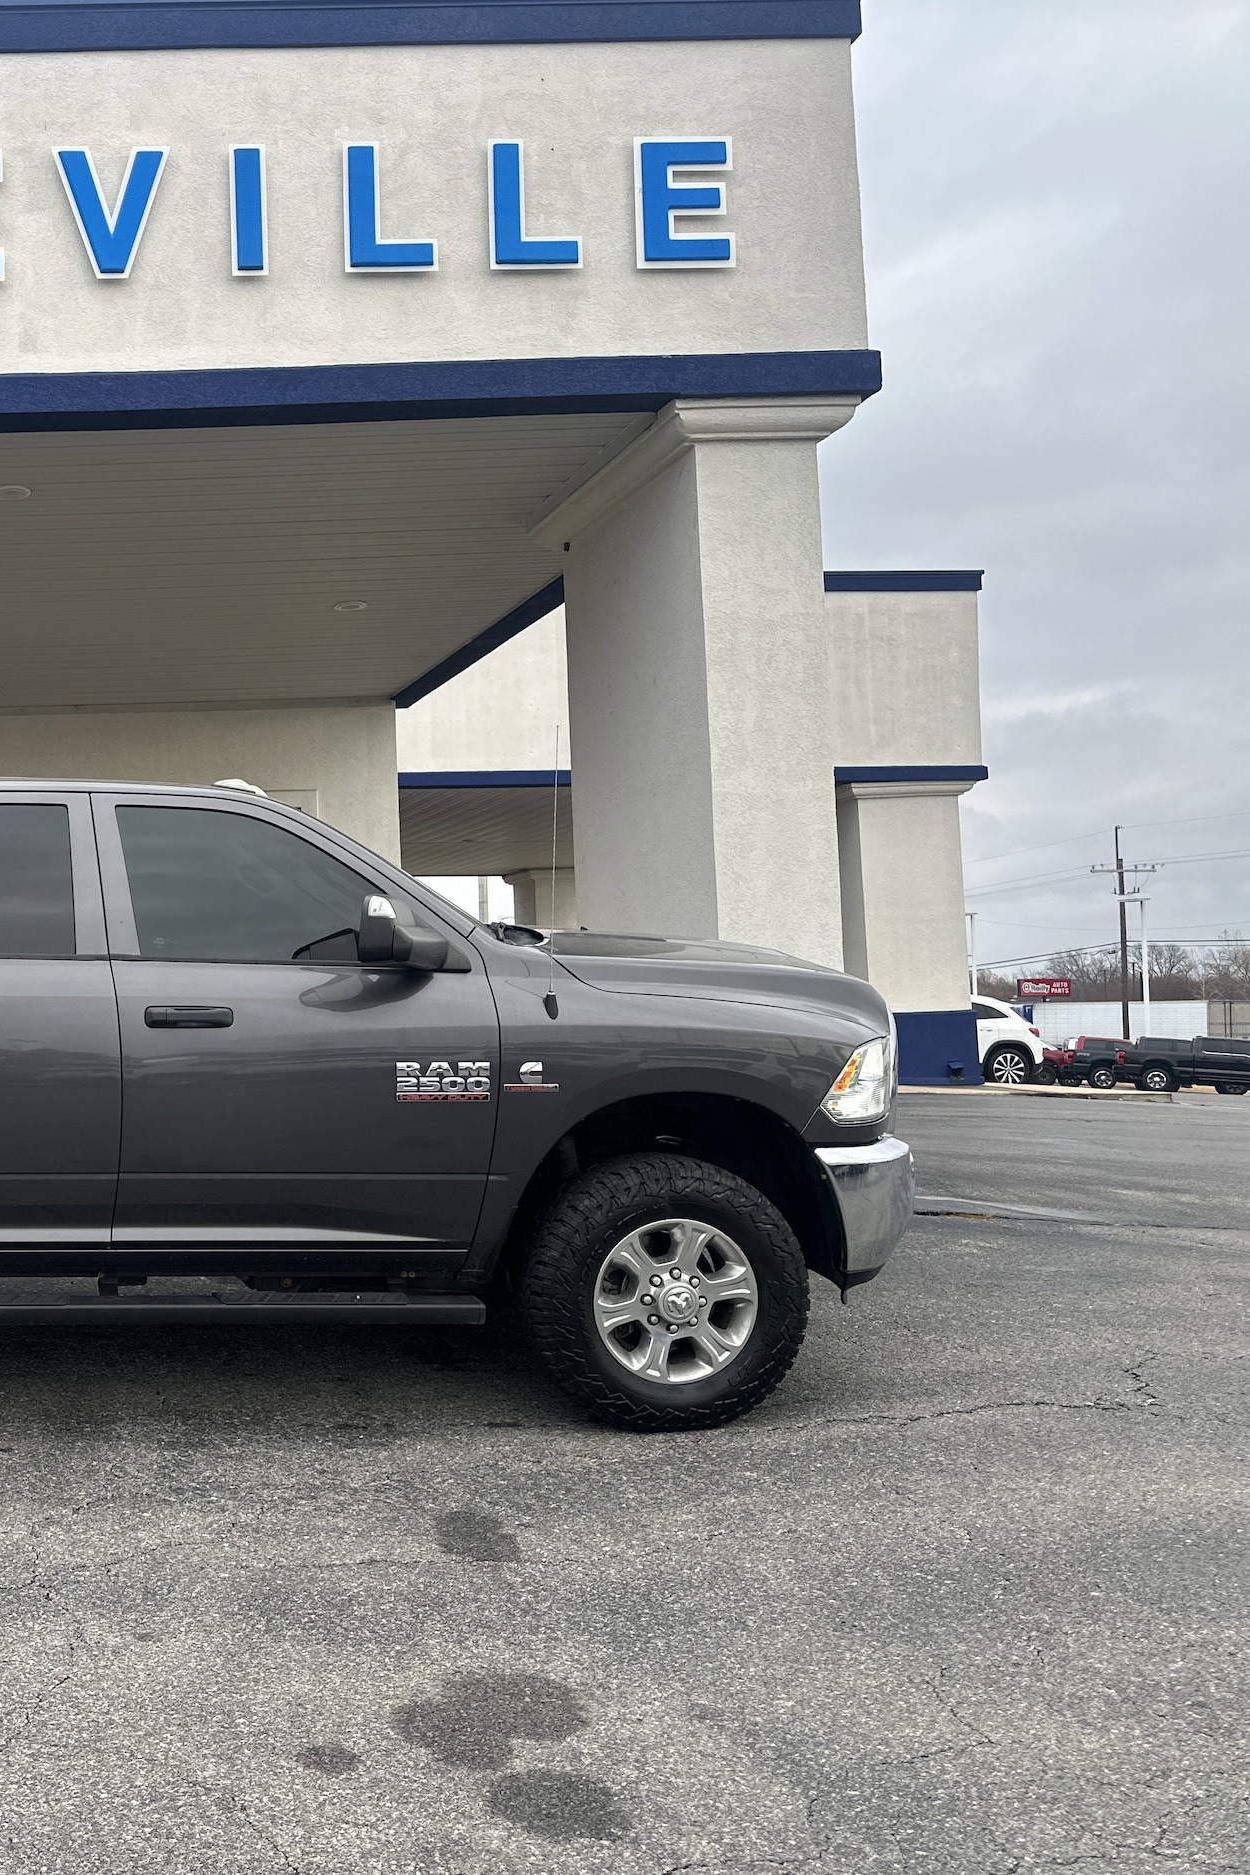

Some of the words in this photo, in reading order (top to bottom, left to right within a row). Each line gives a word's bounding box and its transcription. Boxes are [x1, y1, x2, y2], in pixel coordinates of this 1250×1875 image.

[1022, 982, 1050, 994] O'Reilly
[396, 1061, 490, 1076] RAM
[396, 1076, 490, 1092] 2500
[447, 1093, 488, 1101] DUTY
